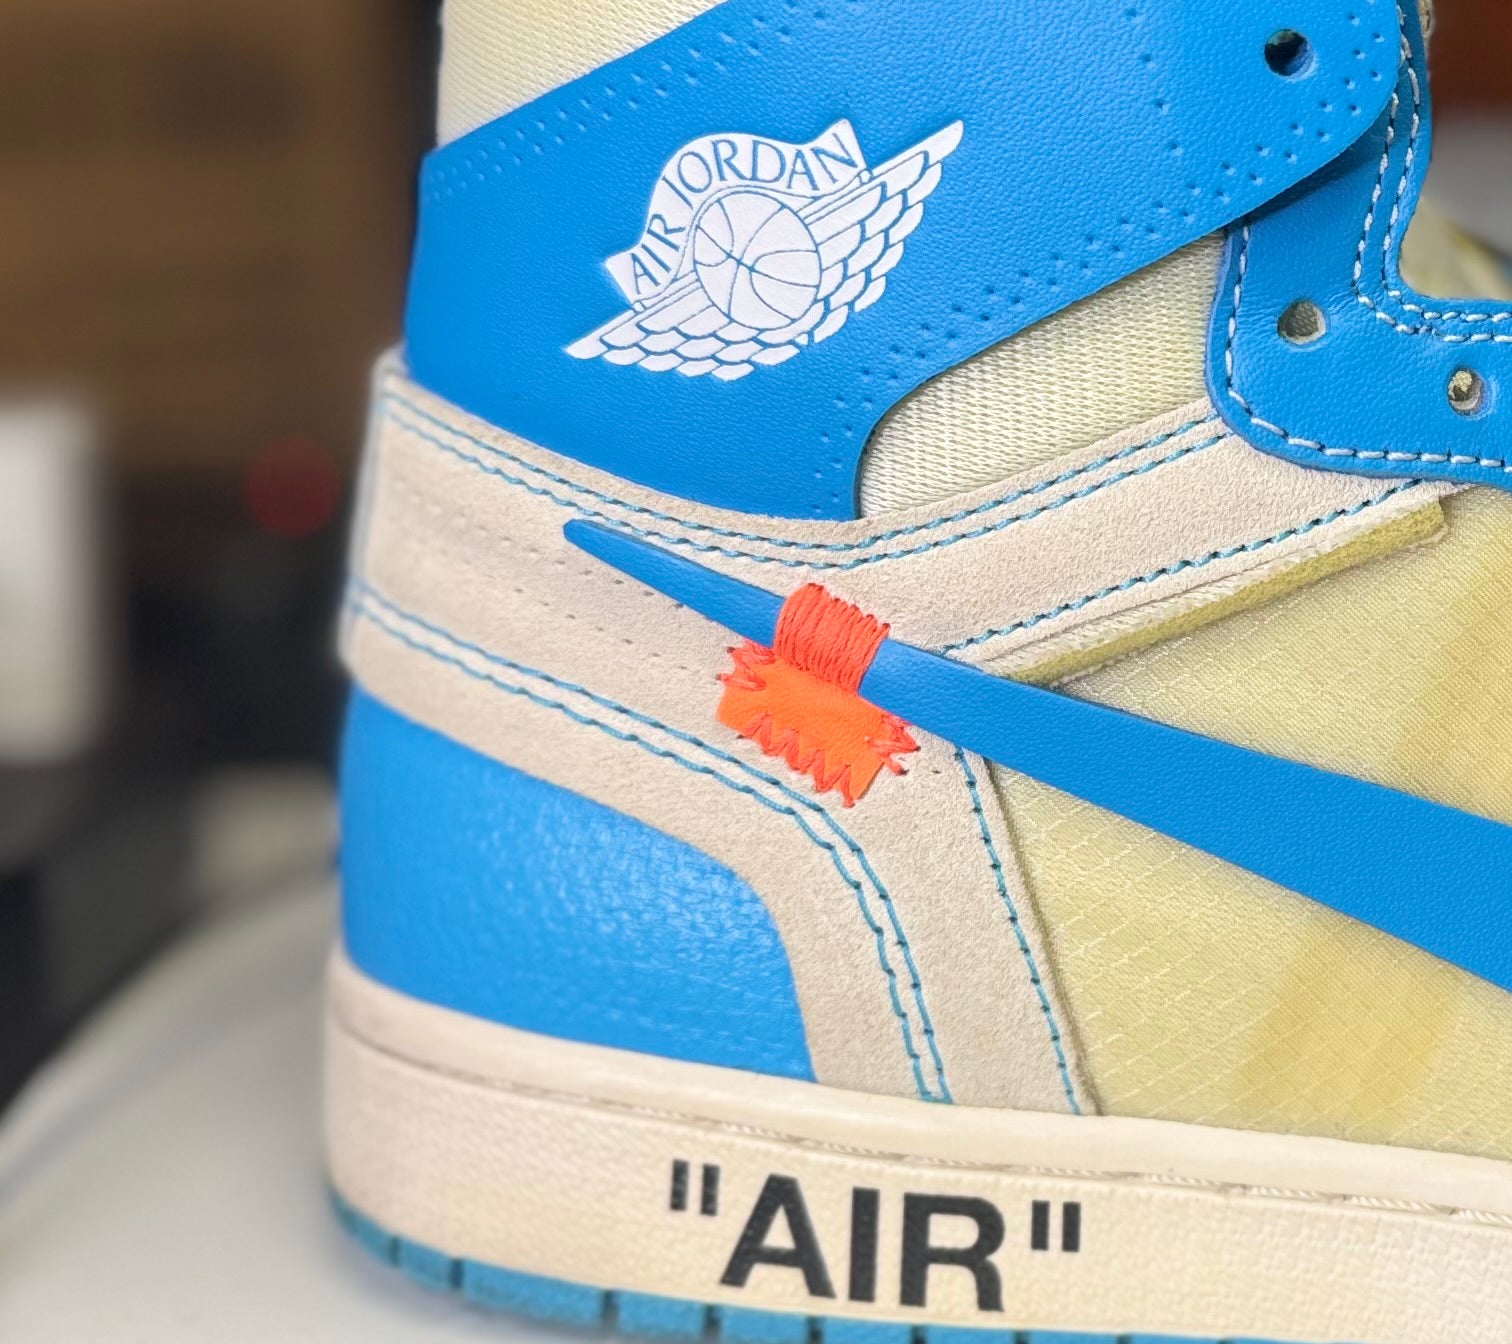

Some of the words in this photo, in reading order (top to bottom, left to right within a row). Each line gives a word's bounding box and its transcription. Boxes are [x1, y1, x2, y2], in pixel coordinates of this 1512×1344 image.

[629, 212, 684, 295] AIR
[660, 132, 859, 210] JORDAN
[669, 1159, 1081, 1312] "AIR"
